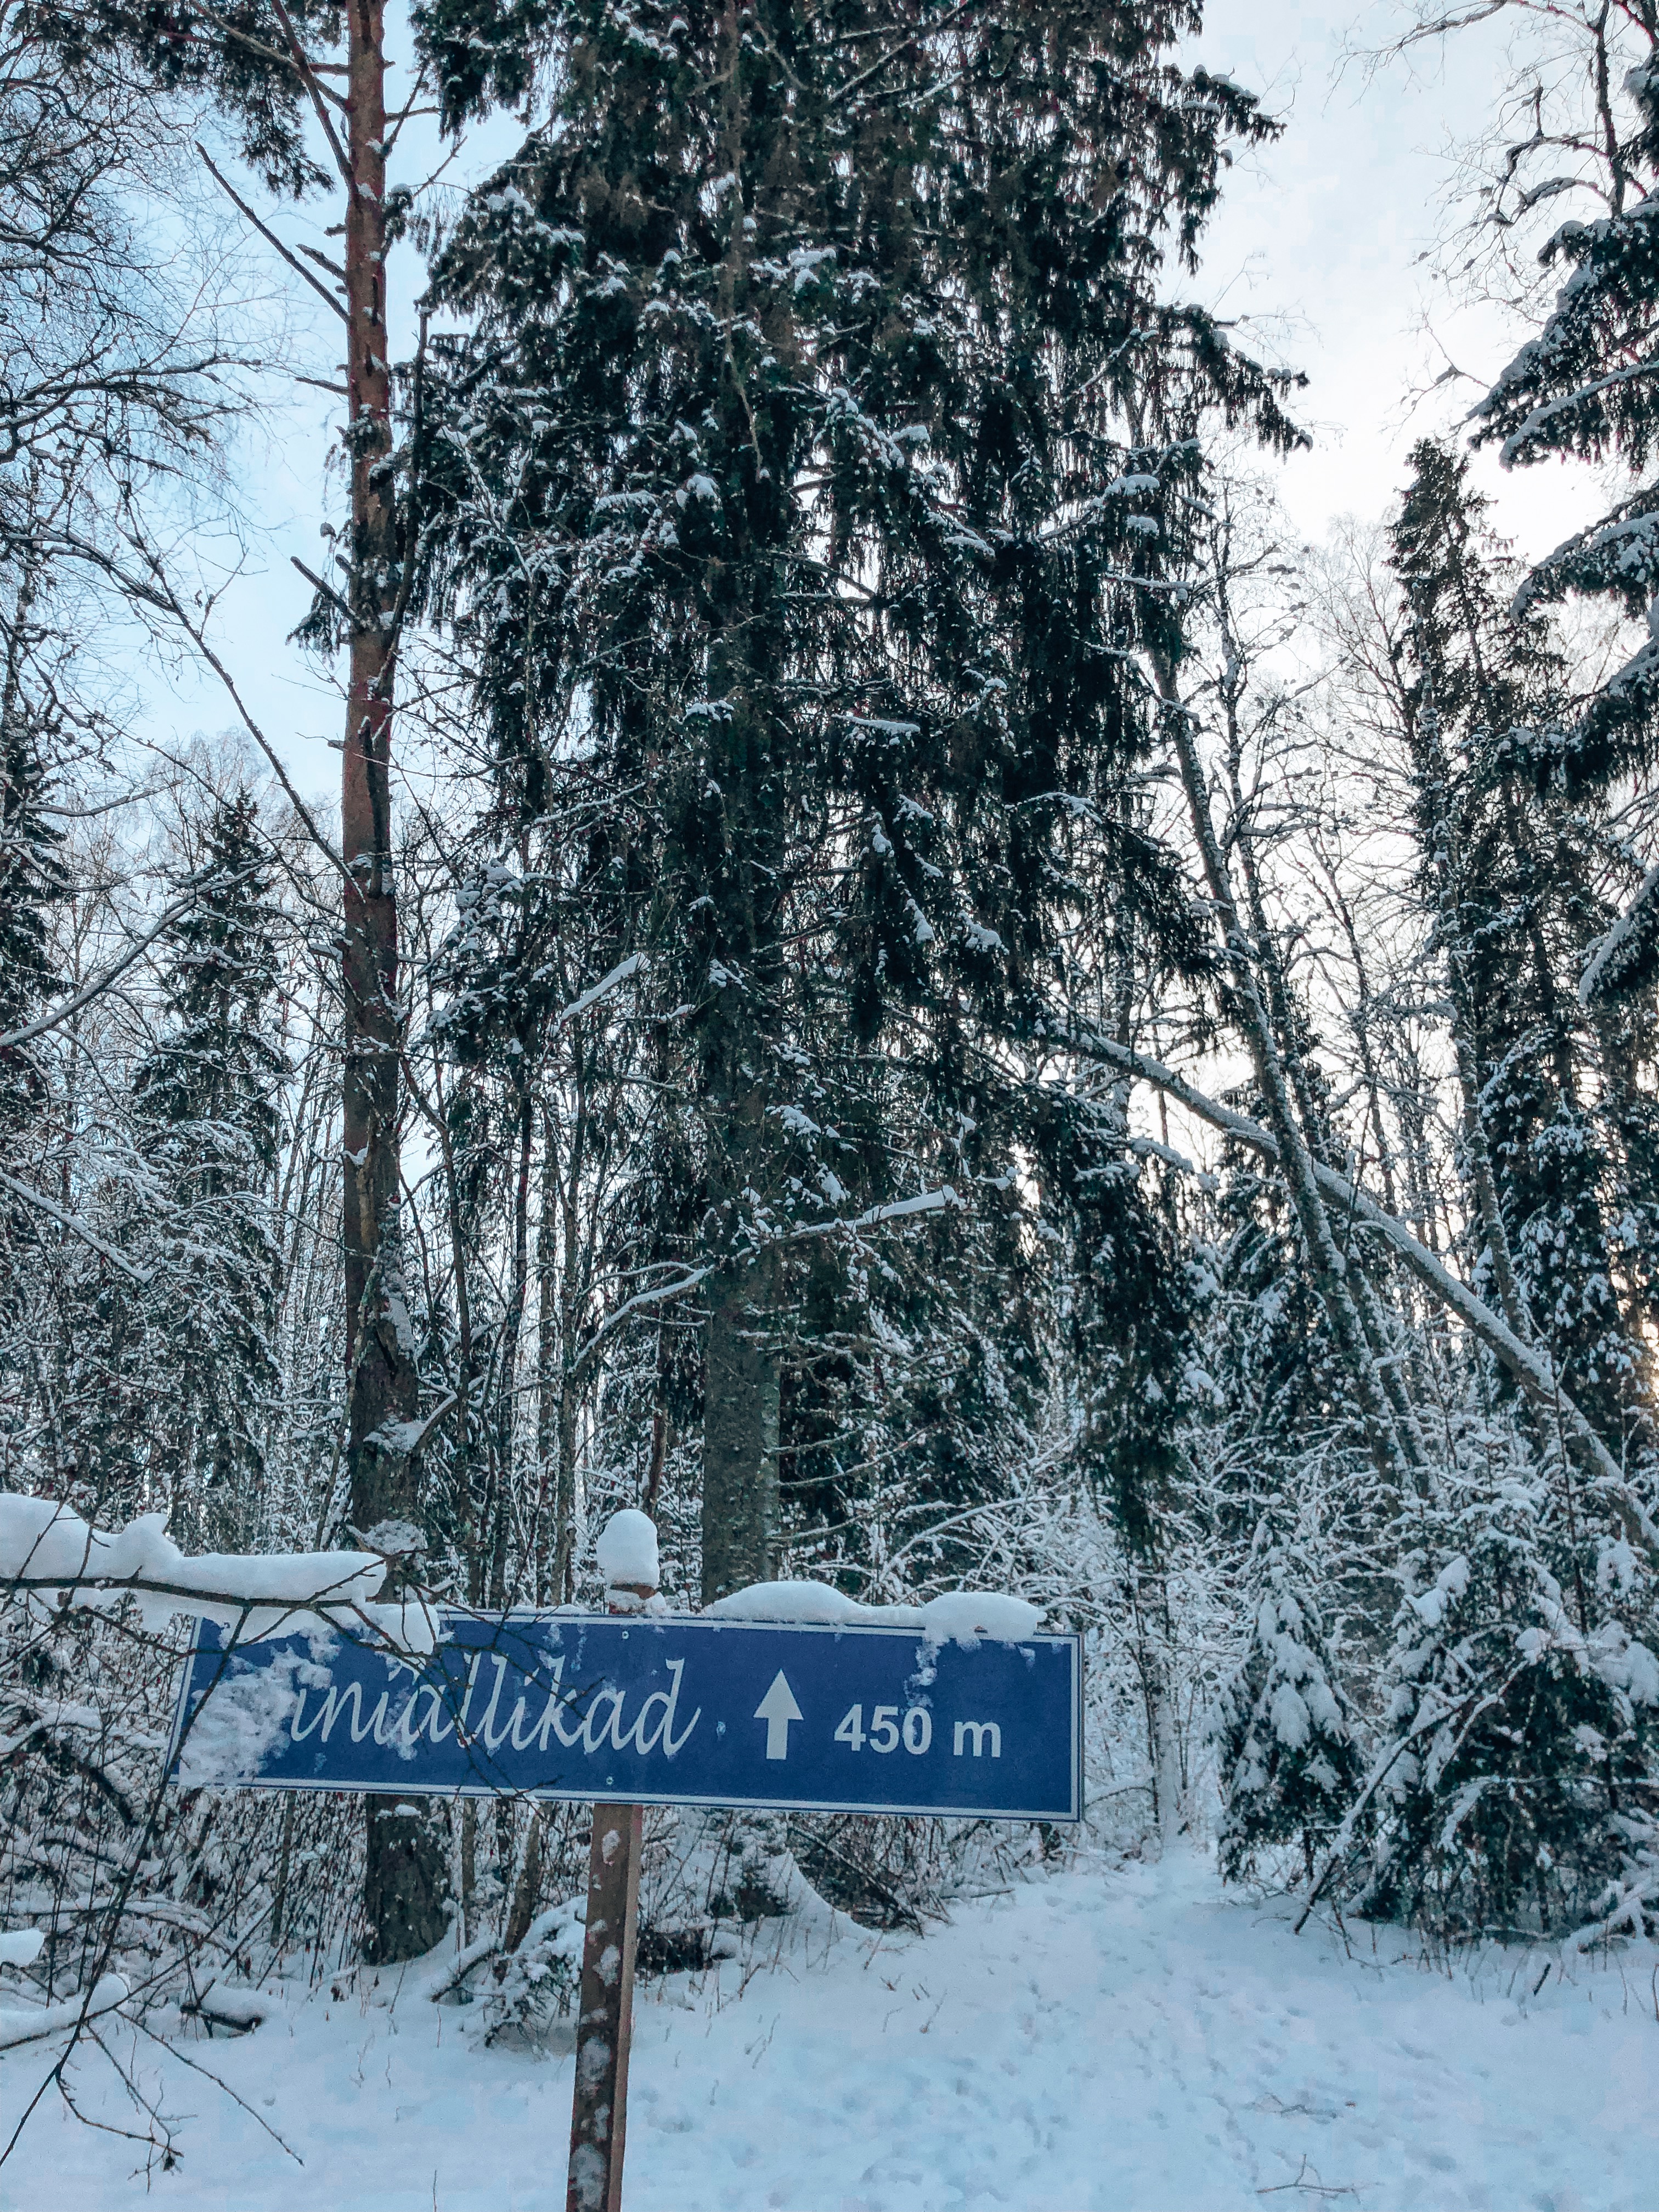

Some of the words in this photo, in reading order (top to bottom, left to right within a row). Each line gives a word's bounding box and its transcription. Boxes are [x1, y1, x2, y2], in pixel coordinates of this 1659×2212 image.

[241, 1651, 702, 1757] iniallikad
[834, 1703, 933, 1755] 450
[953, 1719, 1002, 1758] m
